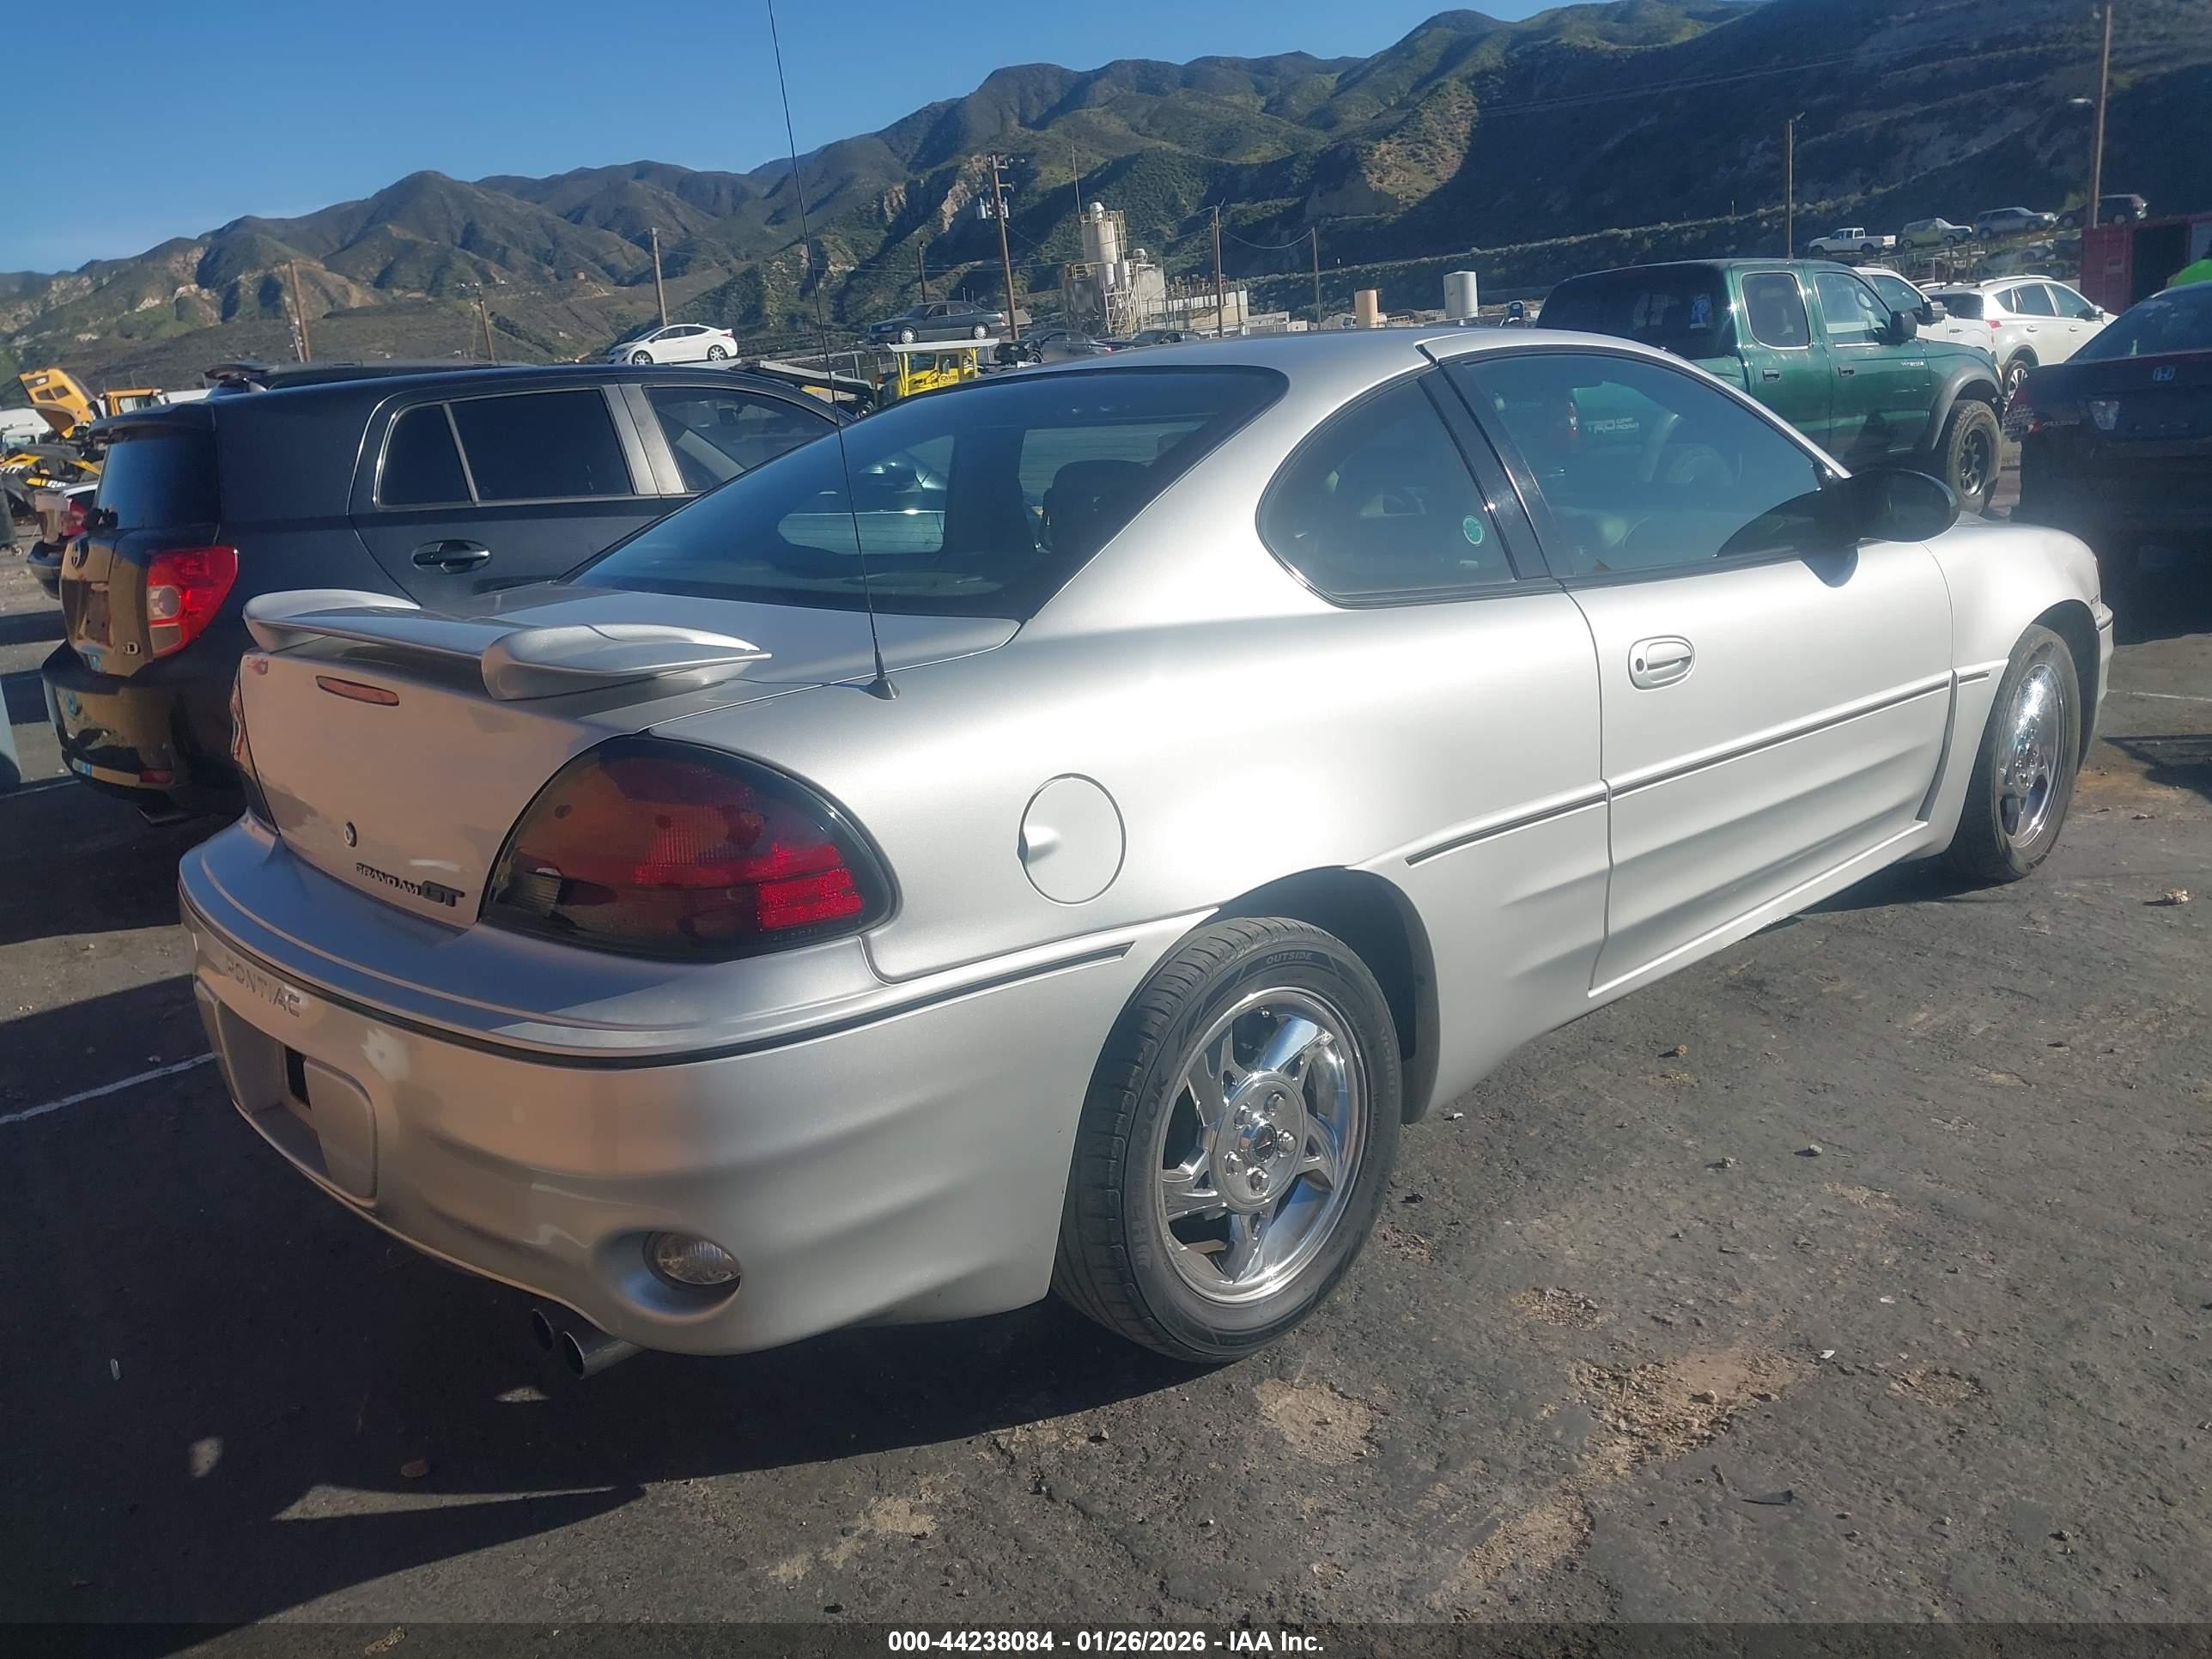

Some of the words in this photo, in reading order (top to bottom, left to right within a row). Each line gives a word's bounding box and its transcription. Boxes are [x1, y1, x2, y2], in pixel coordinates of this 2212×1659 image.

[356, 862, 399, 888] GRAND
[399, 880, 422, 896] AM
[421, 880, 465, 907] GT
[1266, 951, 1313, 965] OUTSIDE
[227, 956, 301, 1018] PONTIAC
